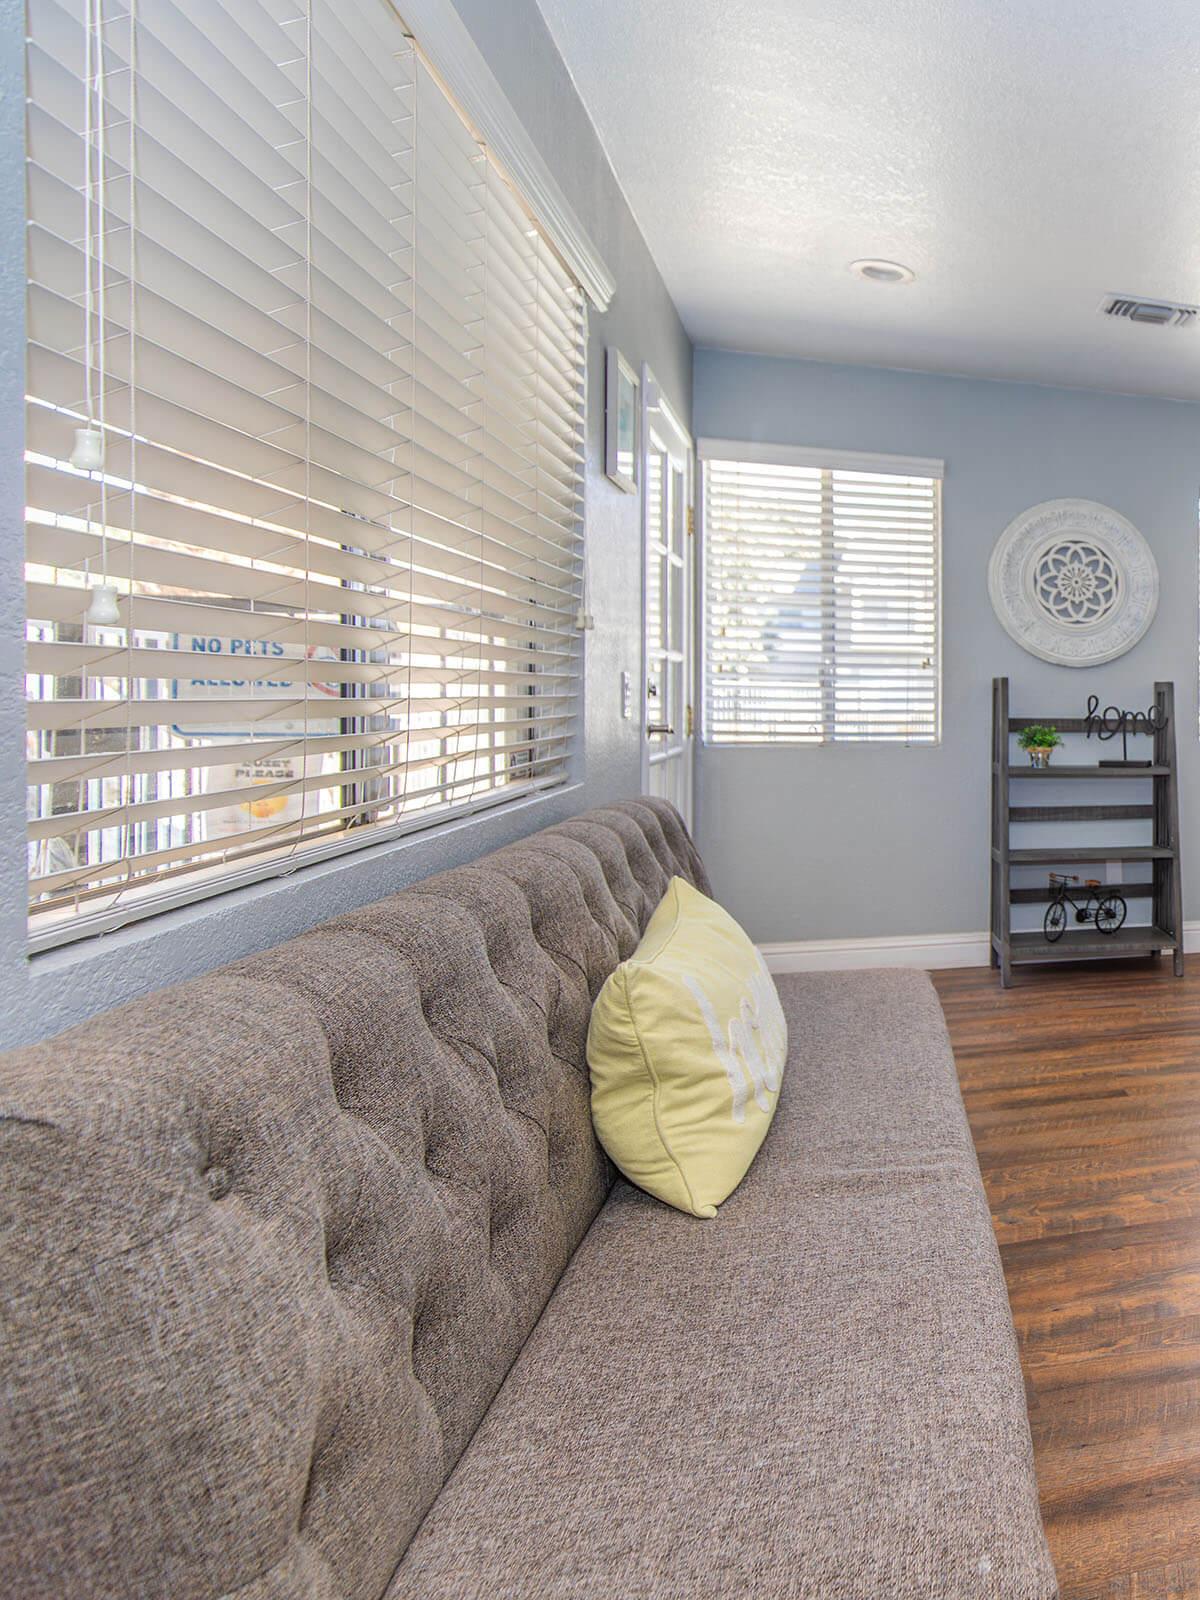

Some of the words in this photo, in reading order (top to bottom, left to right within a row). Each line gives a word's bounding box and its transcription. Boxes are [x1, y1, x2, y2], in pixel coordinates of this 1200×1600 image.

[191, 637, 222, 653] NO
[230, 639, 285, 656] PETS
[1083, 694, 1169, 740] home
[234, 769, 295, 778] PLEASE
